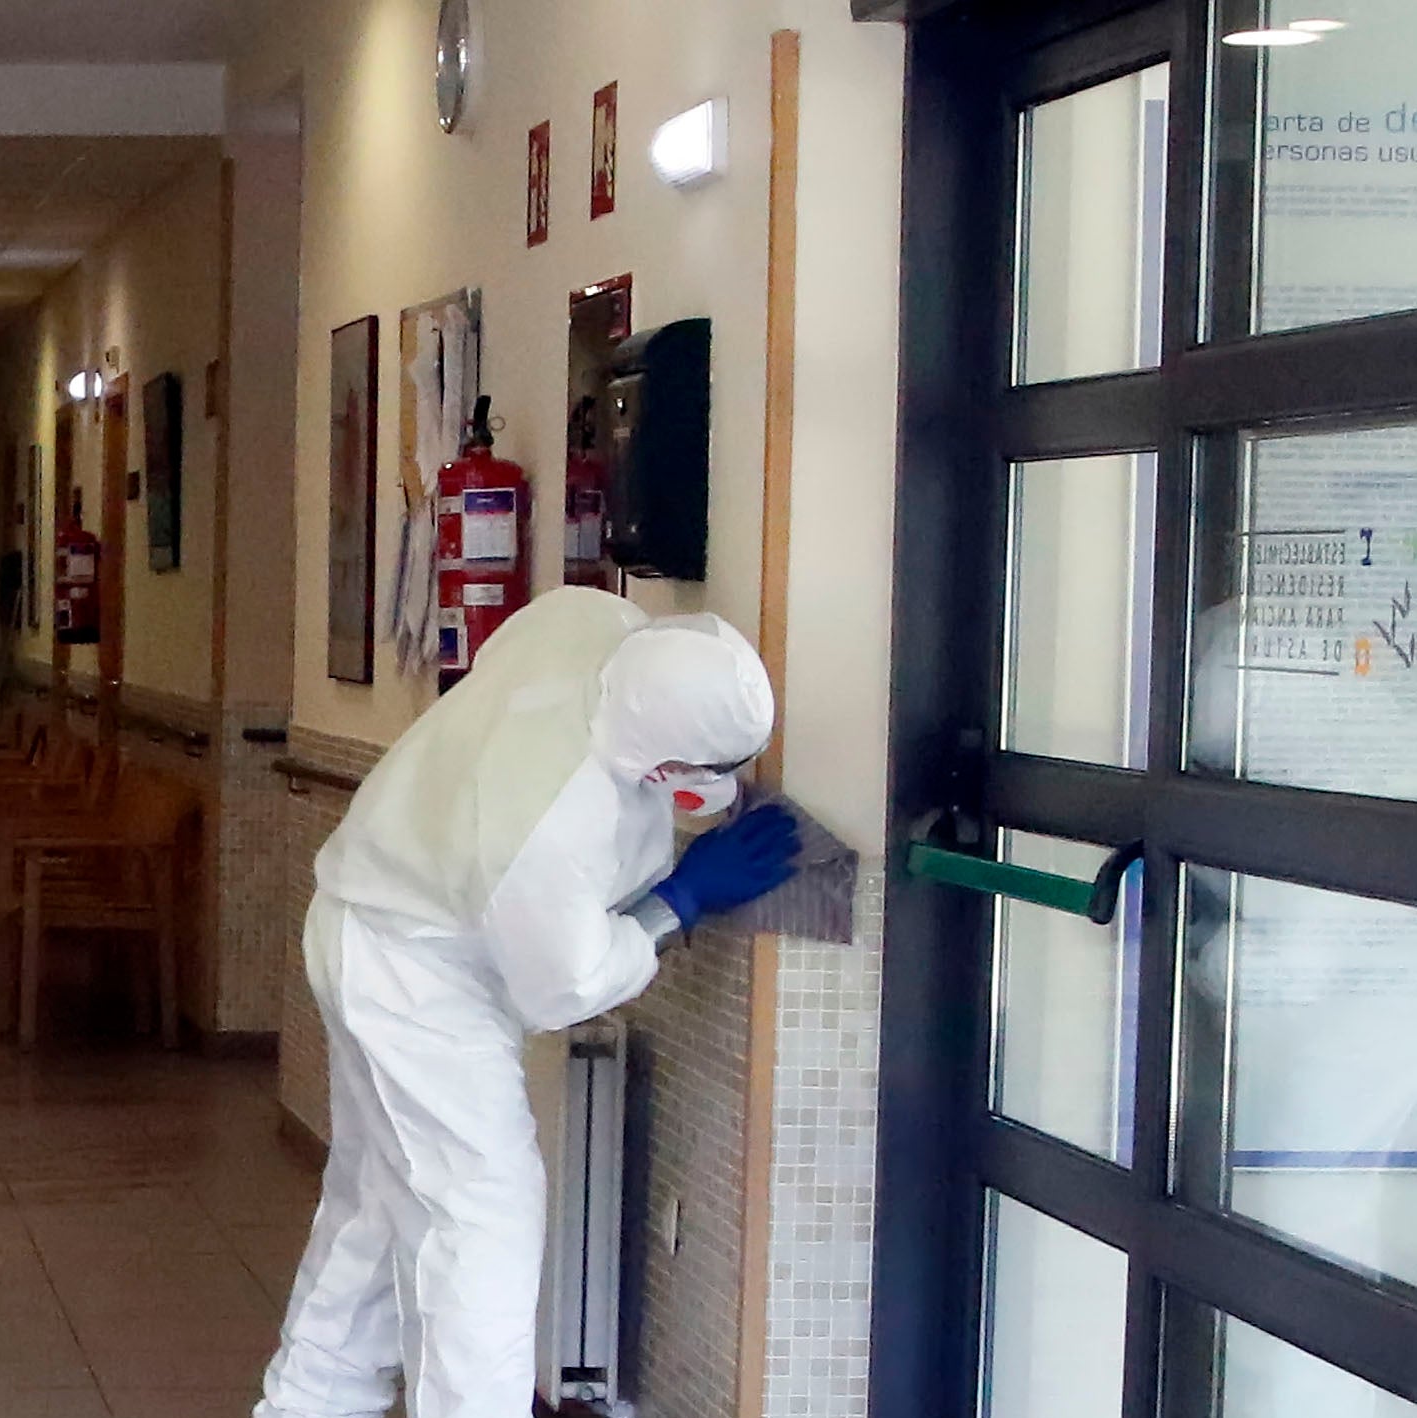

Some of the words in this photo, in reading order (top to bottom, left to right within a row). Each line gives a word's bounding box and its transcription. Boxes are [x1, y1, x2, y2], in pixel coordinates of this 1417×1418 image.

[1266, 113, 1323, 132] arta
[1337, 111, 1370, 133] de
[1265, 144, 1368, 162] ersonas
